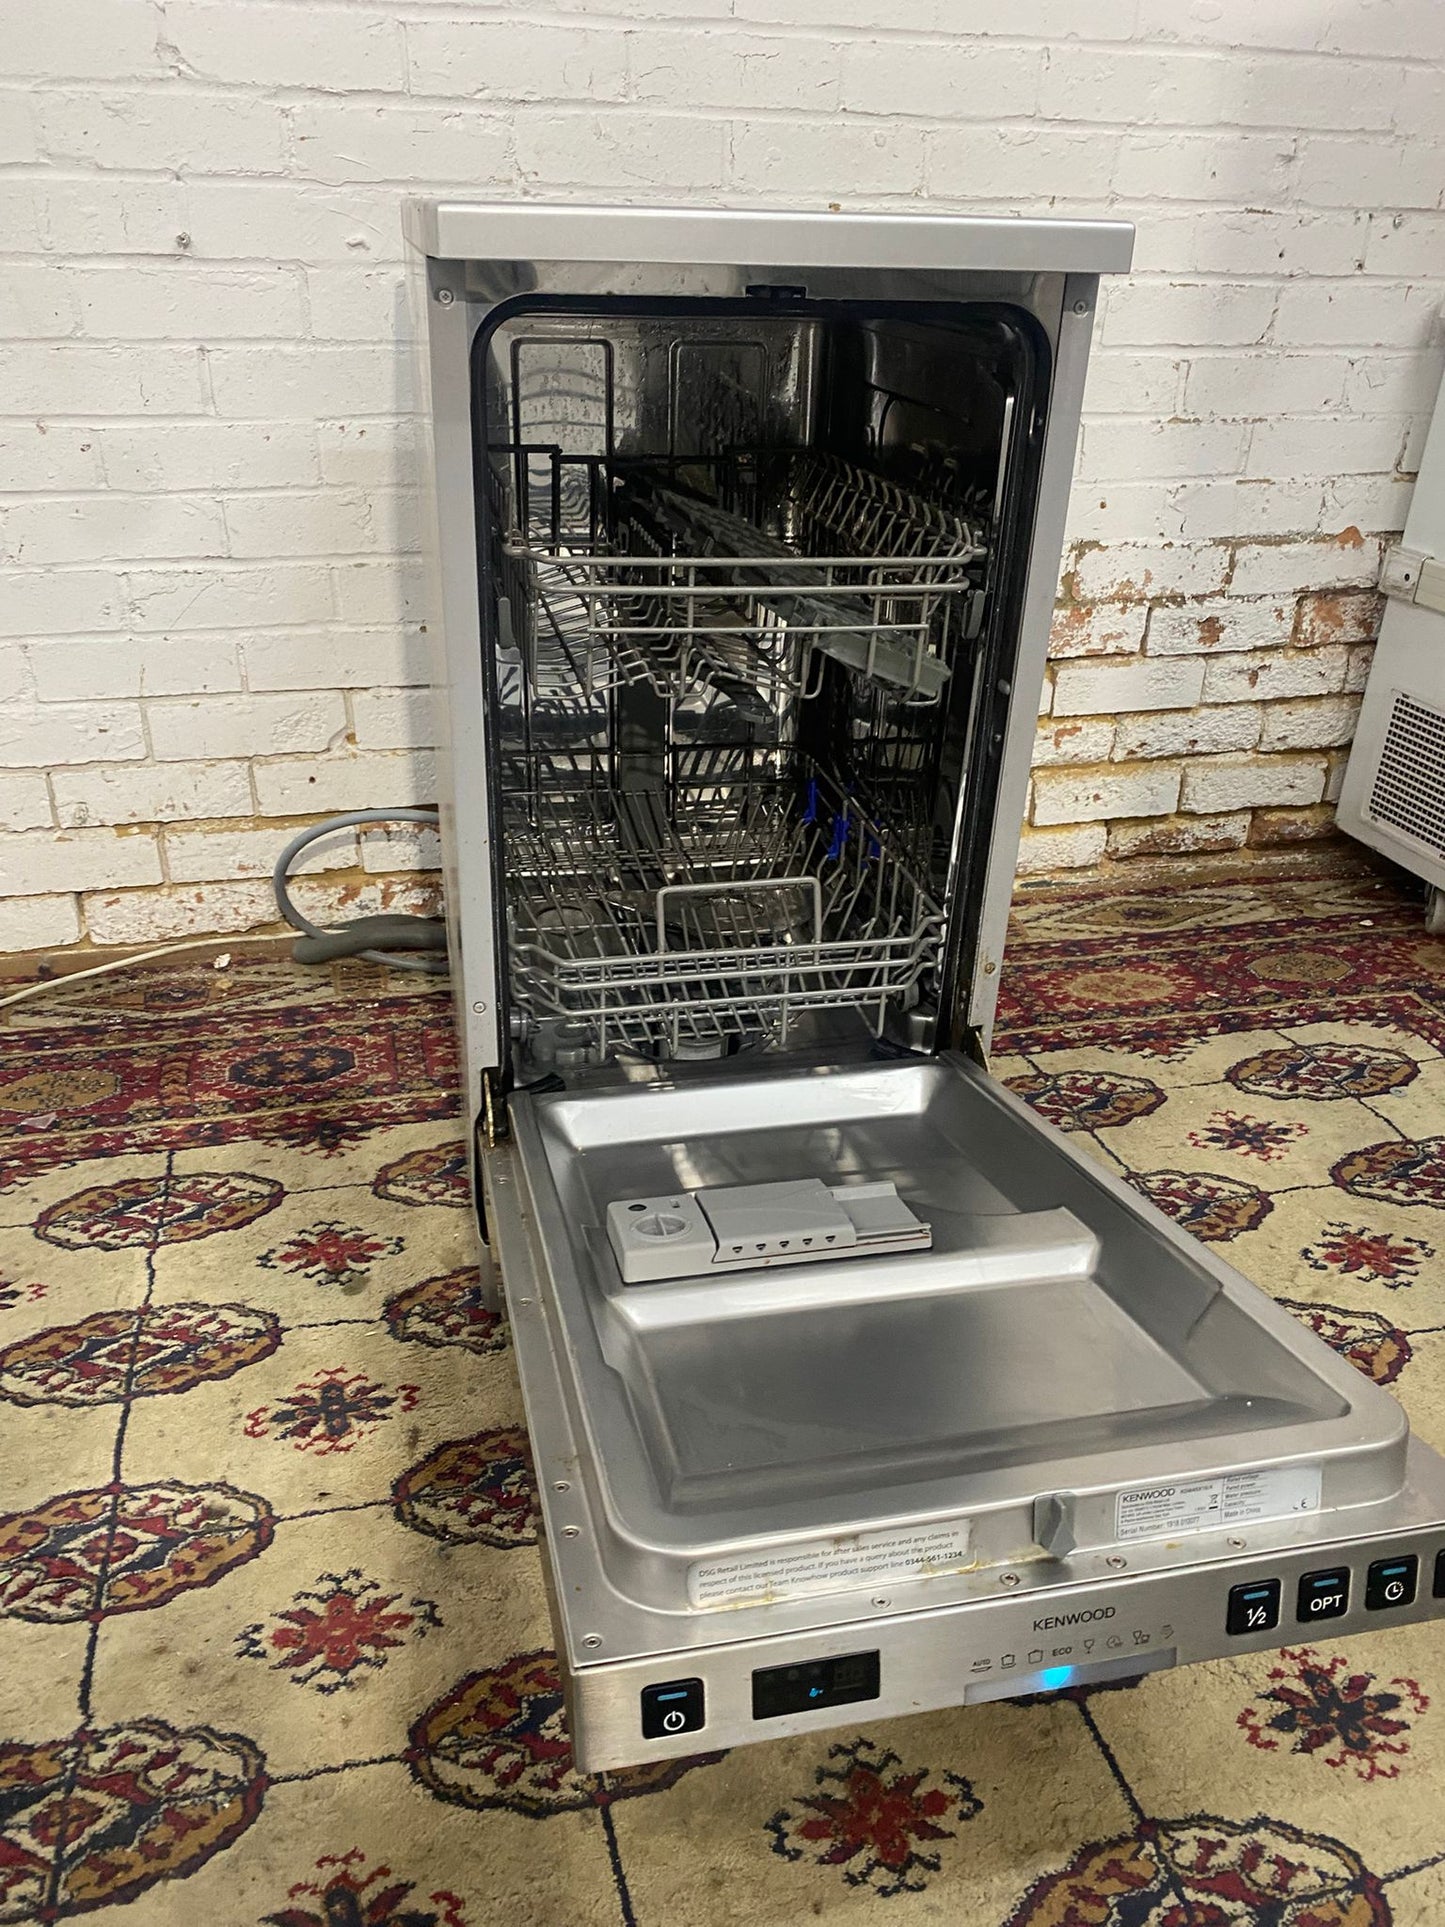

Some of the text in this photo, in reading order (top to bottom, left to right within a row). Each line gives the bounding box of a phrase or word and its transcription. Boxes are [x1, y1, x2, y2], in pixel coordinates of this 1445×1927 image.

[1122, 1488, 1176, 1503] KENWOOD
[1120, 1526, 1138, 1536] Serial
[699, 1567, 716, 1578] DSG
[717, 1564, 738, 1574] Retail
[740, 1560, 768, 1571] Limited
[770, 1558, 776, 1566] is
[777, 1552, 820, 1565] responsible
[821, 1549, 832, 1557] for
[833, 1547, 851, 1556] after
[852, 1544, 870, 1553] sales
[871, 1541, 896, 1550] service
[898, 1537, 912, 1546] and
[914, 1535, 926, 1545] any
[928, 1531, 950, 1541] claims
[699, 1577, 728, 1589] respect
[729, 1574, 738, 1584] of
[738, 1573, 752, 1583] this
[752, 1568, 785, 1580] licensed
[785, 1563, 816, 1576] product.
[825, 1561, 839, 1570] you
[840, 1557, 858, 1565] have
[866, 1553, 887, 1563] query
[888, 1548, 909, 1558] about
[911, 1545, 923, 1554] the
[924, 1541, 953, 1553] product
[699, 1589, 724, 1600] please
[725, 1583, 754, 1595] contact
[755, 1582, 768, 1590] our
[769, 1577, 790, 1588] Team
[791, 1572, 829, 1584] Knowhow
[829, 1567, 859, 1579] product
[860, 1563, 889, 1574] support
[890, 1560, 903, 1568] line
[1310, 1594, 1343, 1612] OPT
[1033, 1606, 1116, 1632] KENWOOD
[1052, 1646, 1073, 1657] ECO
[973, 1658, 990, 1667] AUTO
